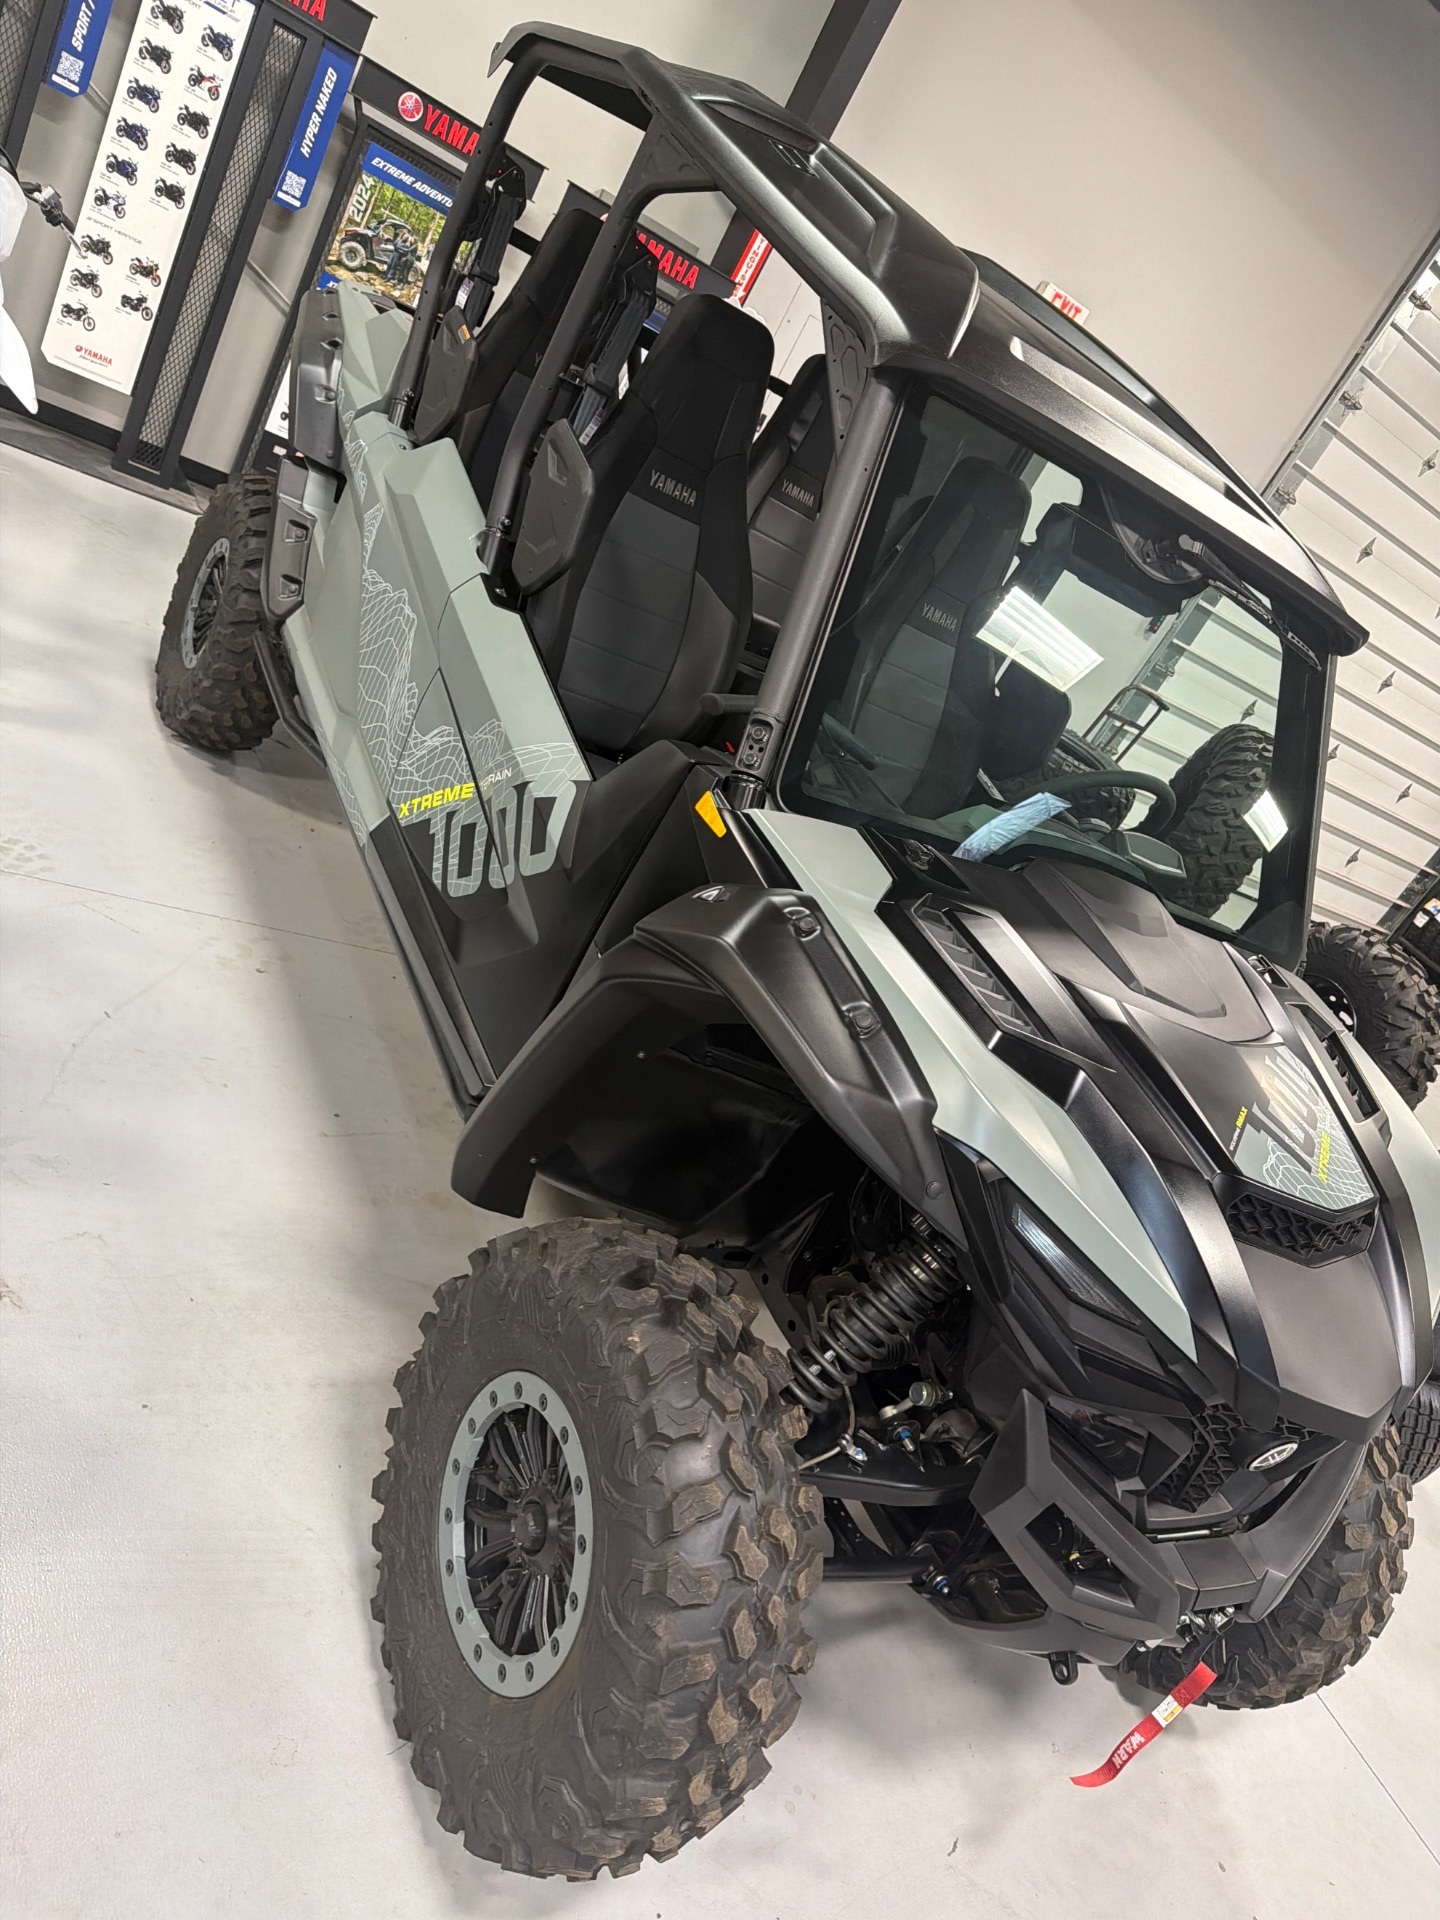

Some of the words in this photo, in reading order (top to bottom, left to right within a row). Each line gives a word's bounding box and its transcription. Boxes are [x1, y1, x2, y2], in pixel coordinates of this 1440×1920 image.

[72, 2, 92, 52] SPORT
[300, 112, 322, 158] HYPER
[315, 66, 338, 116] NAKED
[371, 157, 414, 187] EXTREME
[349, 173, 377, 222] 2024
[636, 230, 700, 290] AMAHA
[83, 347, 113, 366] YAMAHA
[650, 469, 697, 507] YAMAHA
[781, 479, 816, 508] YAMAHA
[922, 603, 958, 632] YAMAHA
[398, 783, 476, 819] XTREME
[429, 780, 577, 898] 1000
[1316, 1131, 1331, 1184] XTREME
[1111, 1731, 1146, 1769] WARN
